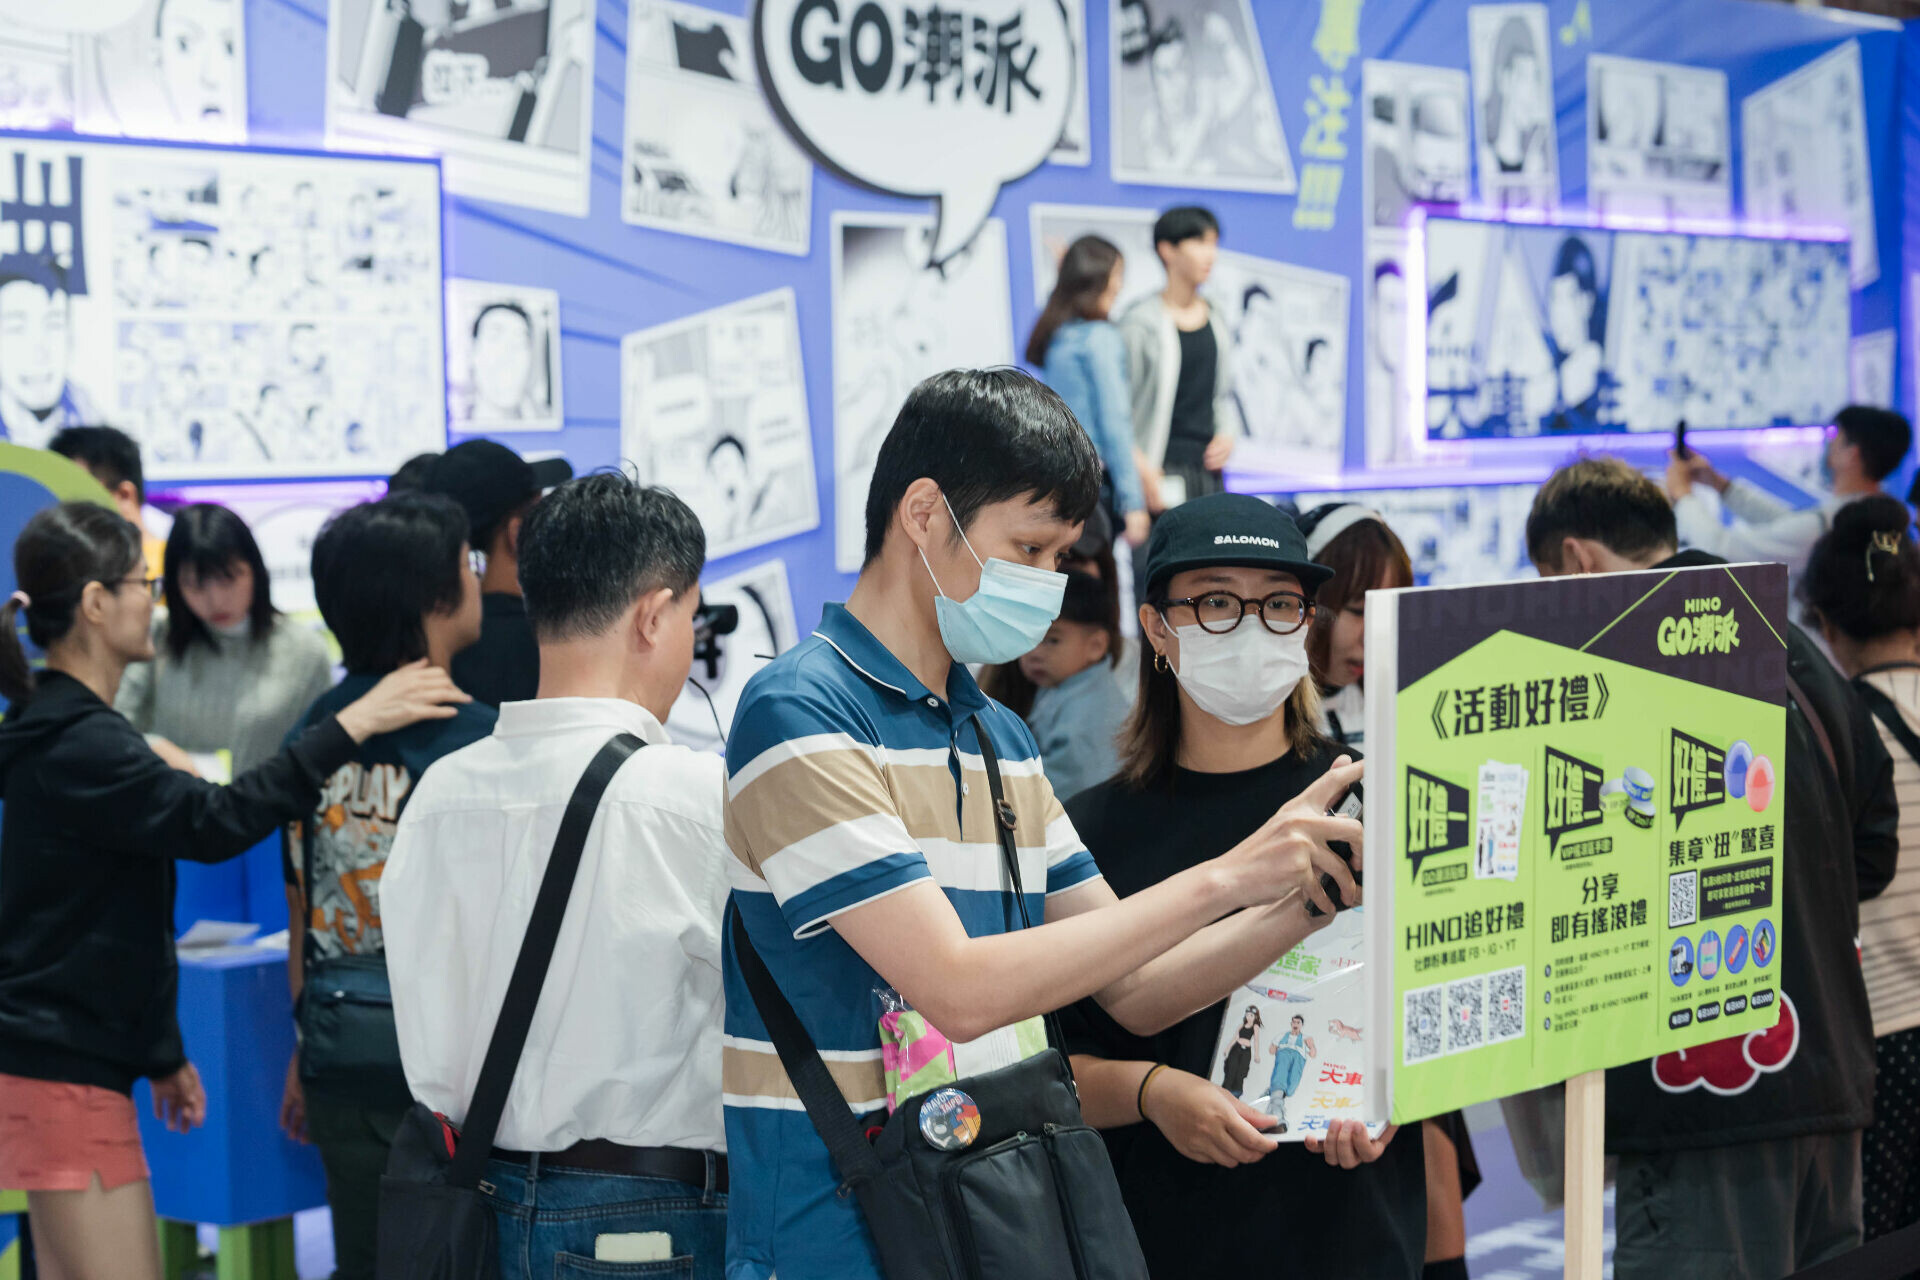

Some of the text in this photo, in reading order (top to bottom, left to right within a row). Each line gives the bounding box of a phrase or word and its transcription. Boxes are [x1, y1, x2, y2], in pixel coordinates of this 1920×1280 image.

[791, 0, 1041, 113] GO潮派
[1214, 535, 1280, 549] SALOMON
[1685, 597, 1722, 613] HINO
[1657, 608, 1740, 656] GO潮派
[1430, 672, 1610, 740] 《活動好禮》
[1582, 873, 1619, 904] 分享
[1406, 902, 1525, 951] HINO追好禮
[1551, 899, 1647, 943] 即有搖滾禮
